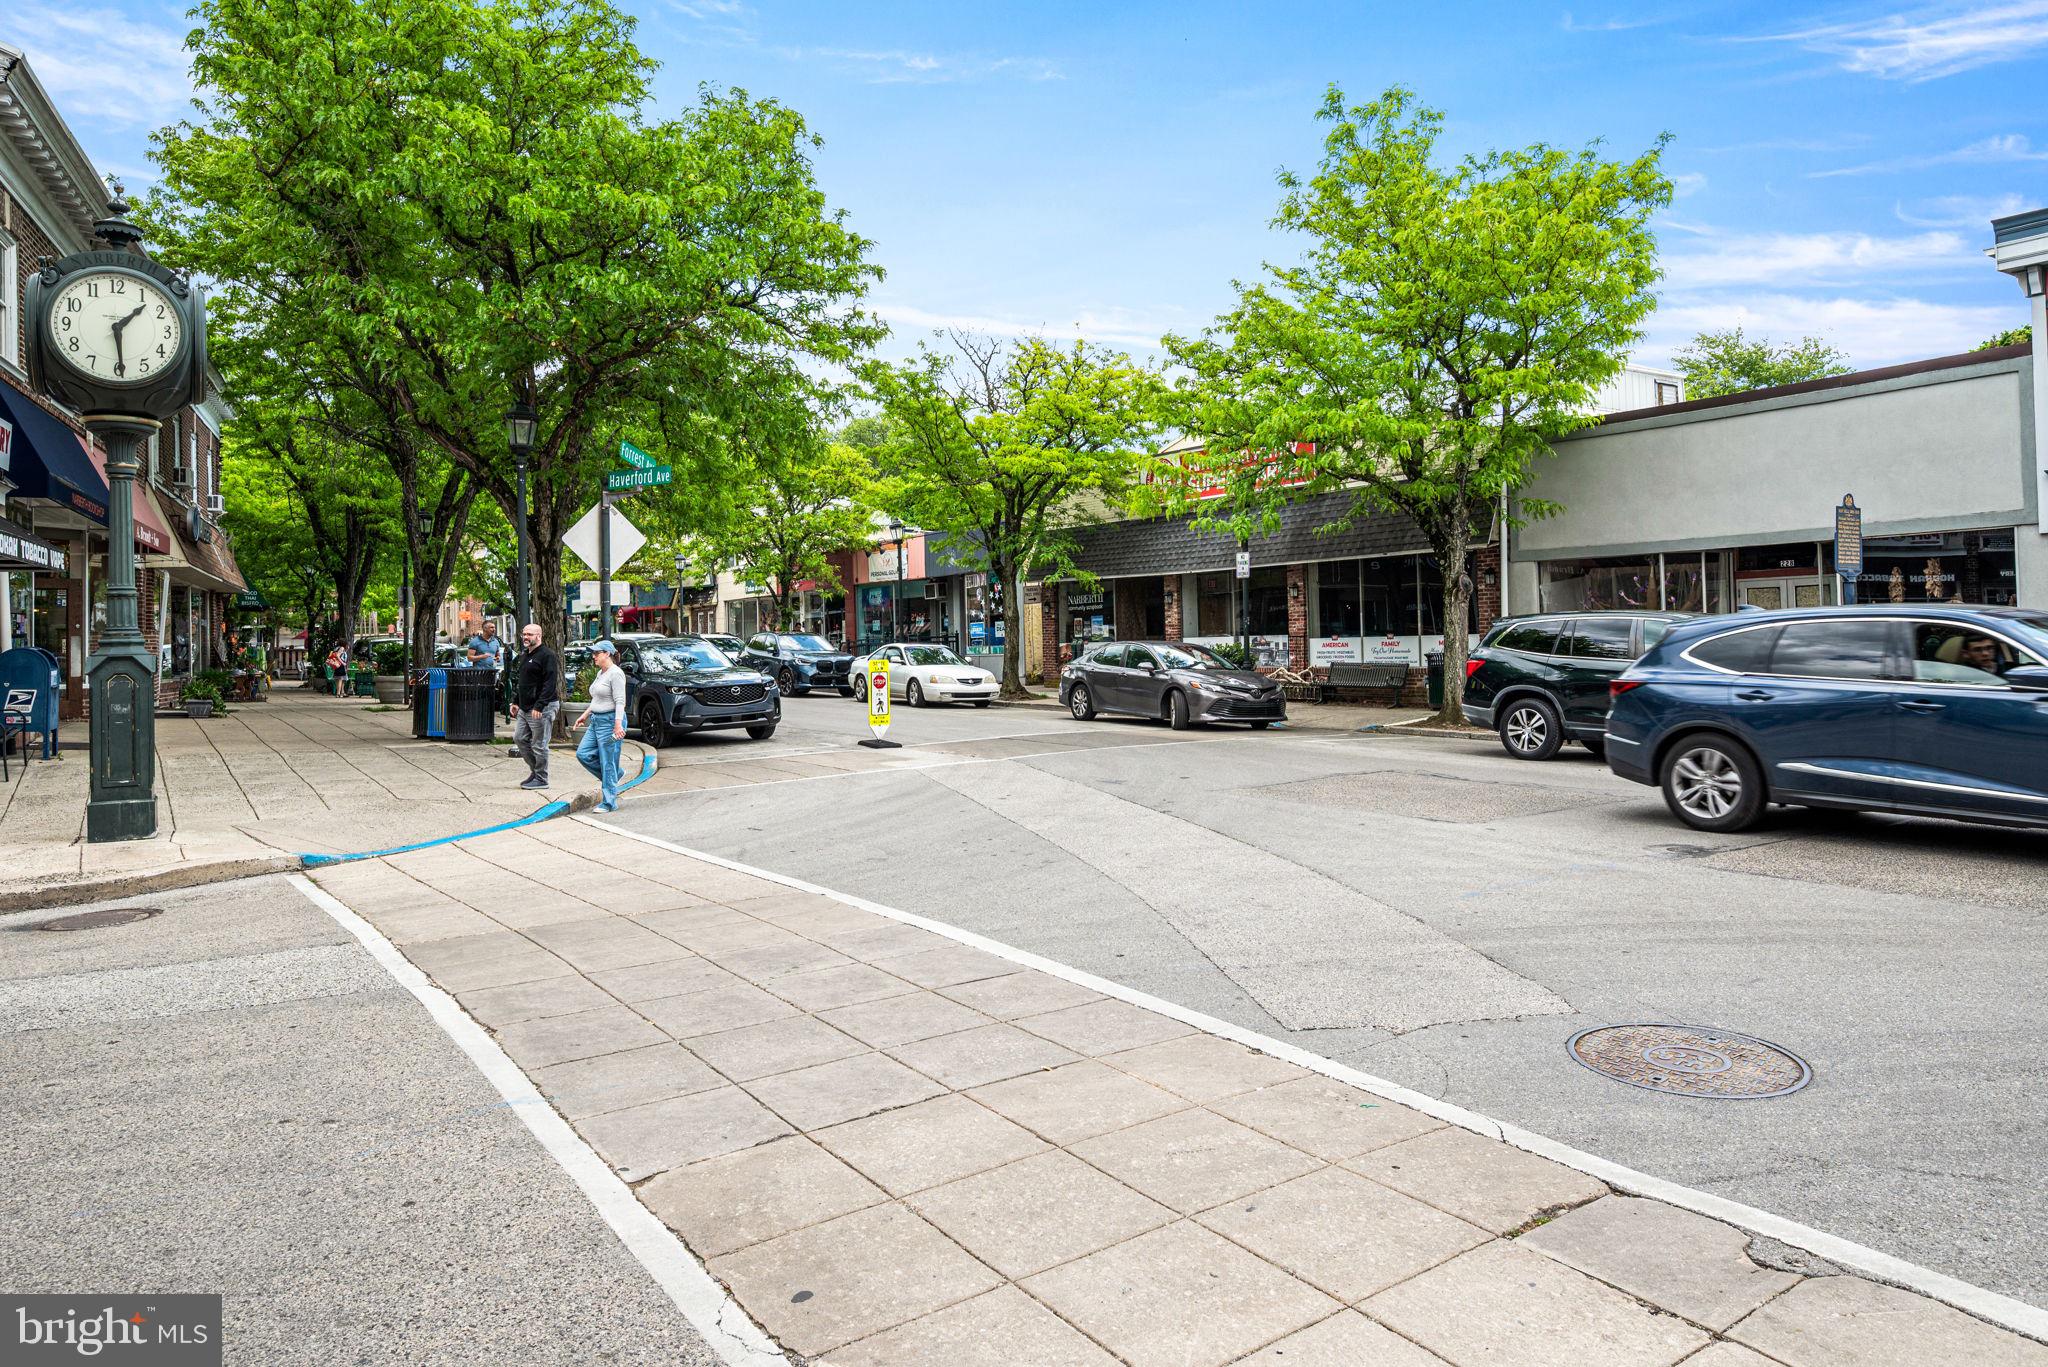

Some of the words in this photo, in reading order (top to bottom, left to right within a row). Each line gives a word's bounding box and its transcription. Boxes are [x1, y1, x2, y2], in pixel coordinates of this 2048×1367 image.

[69, 253, 158, 275] NARBERTH
[87, 283, 99, 298] 11
[110, 279, 126, 295] 12
[139, 288, 145, 302] 1
[66, 297, 82, 312] 10
[155, 304, 165, 320] 2
[61, 316, 71, 331] 9
[163, 325, 172, 340] 3
[69, 337, 79, 352] 8
[155, 343, 166, 358] 4
[86, 355, 97, 370] 7
[113, 362, 123, 377] 6
[139, 358, 149, 372] 5
[621, 442, 645, 468] Forrest
[609, 469, 653, 488] Haverford
[656, 471, 670, 483] Ave
[20, 539, 49, 566] TOBACCO
[49, 549, 65, 570] VAPE
